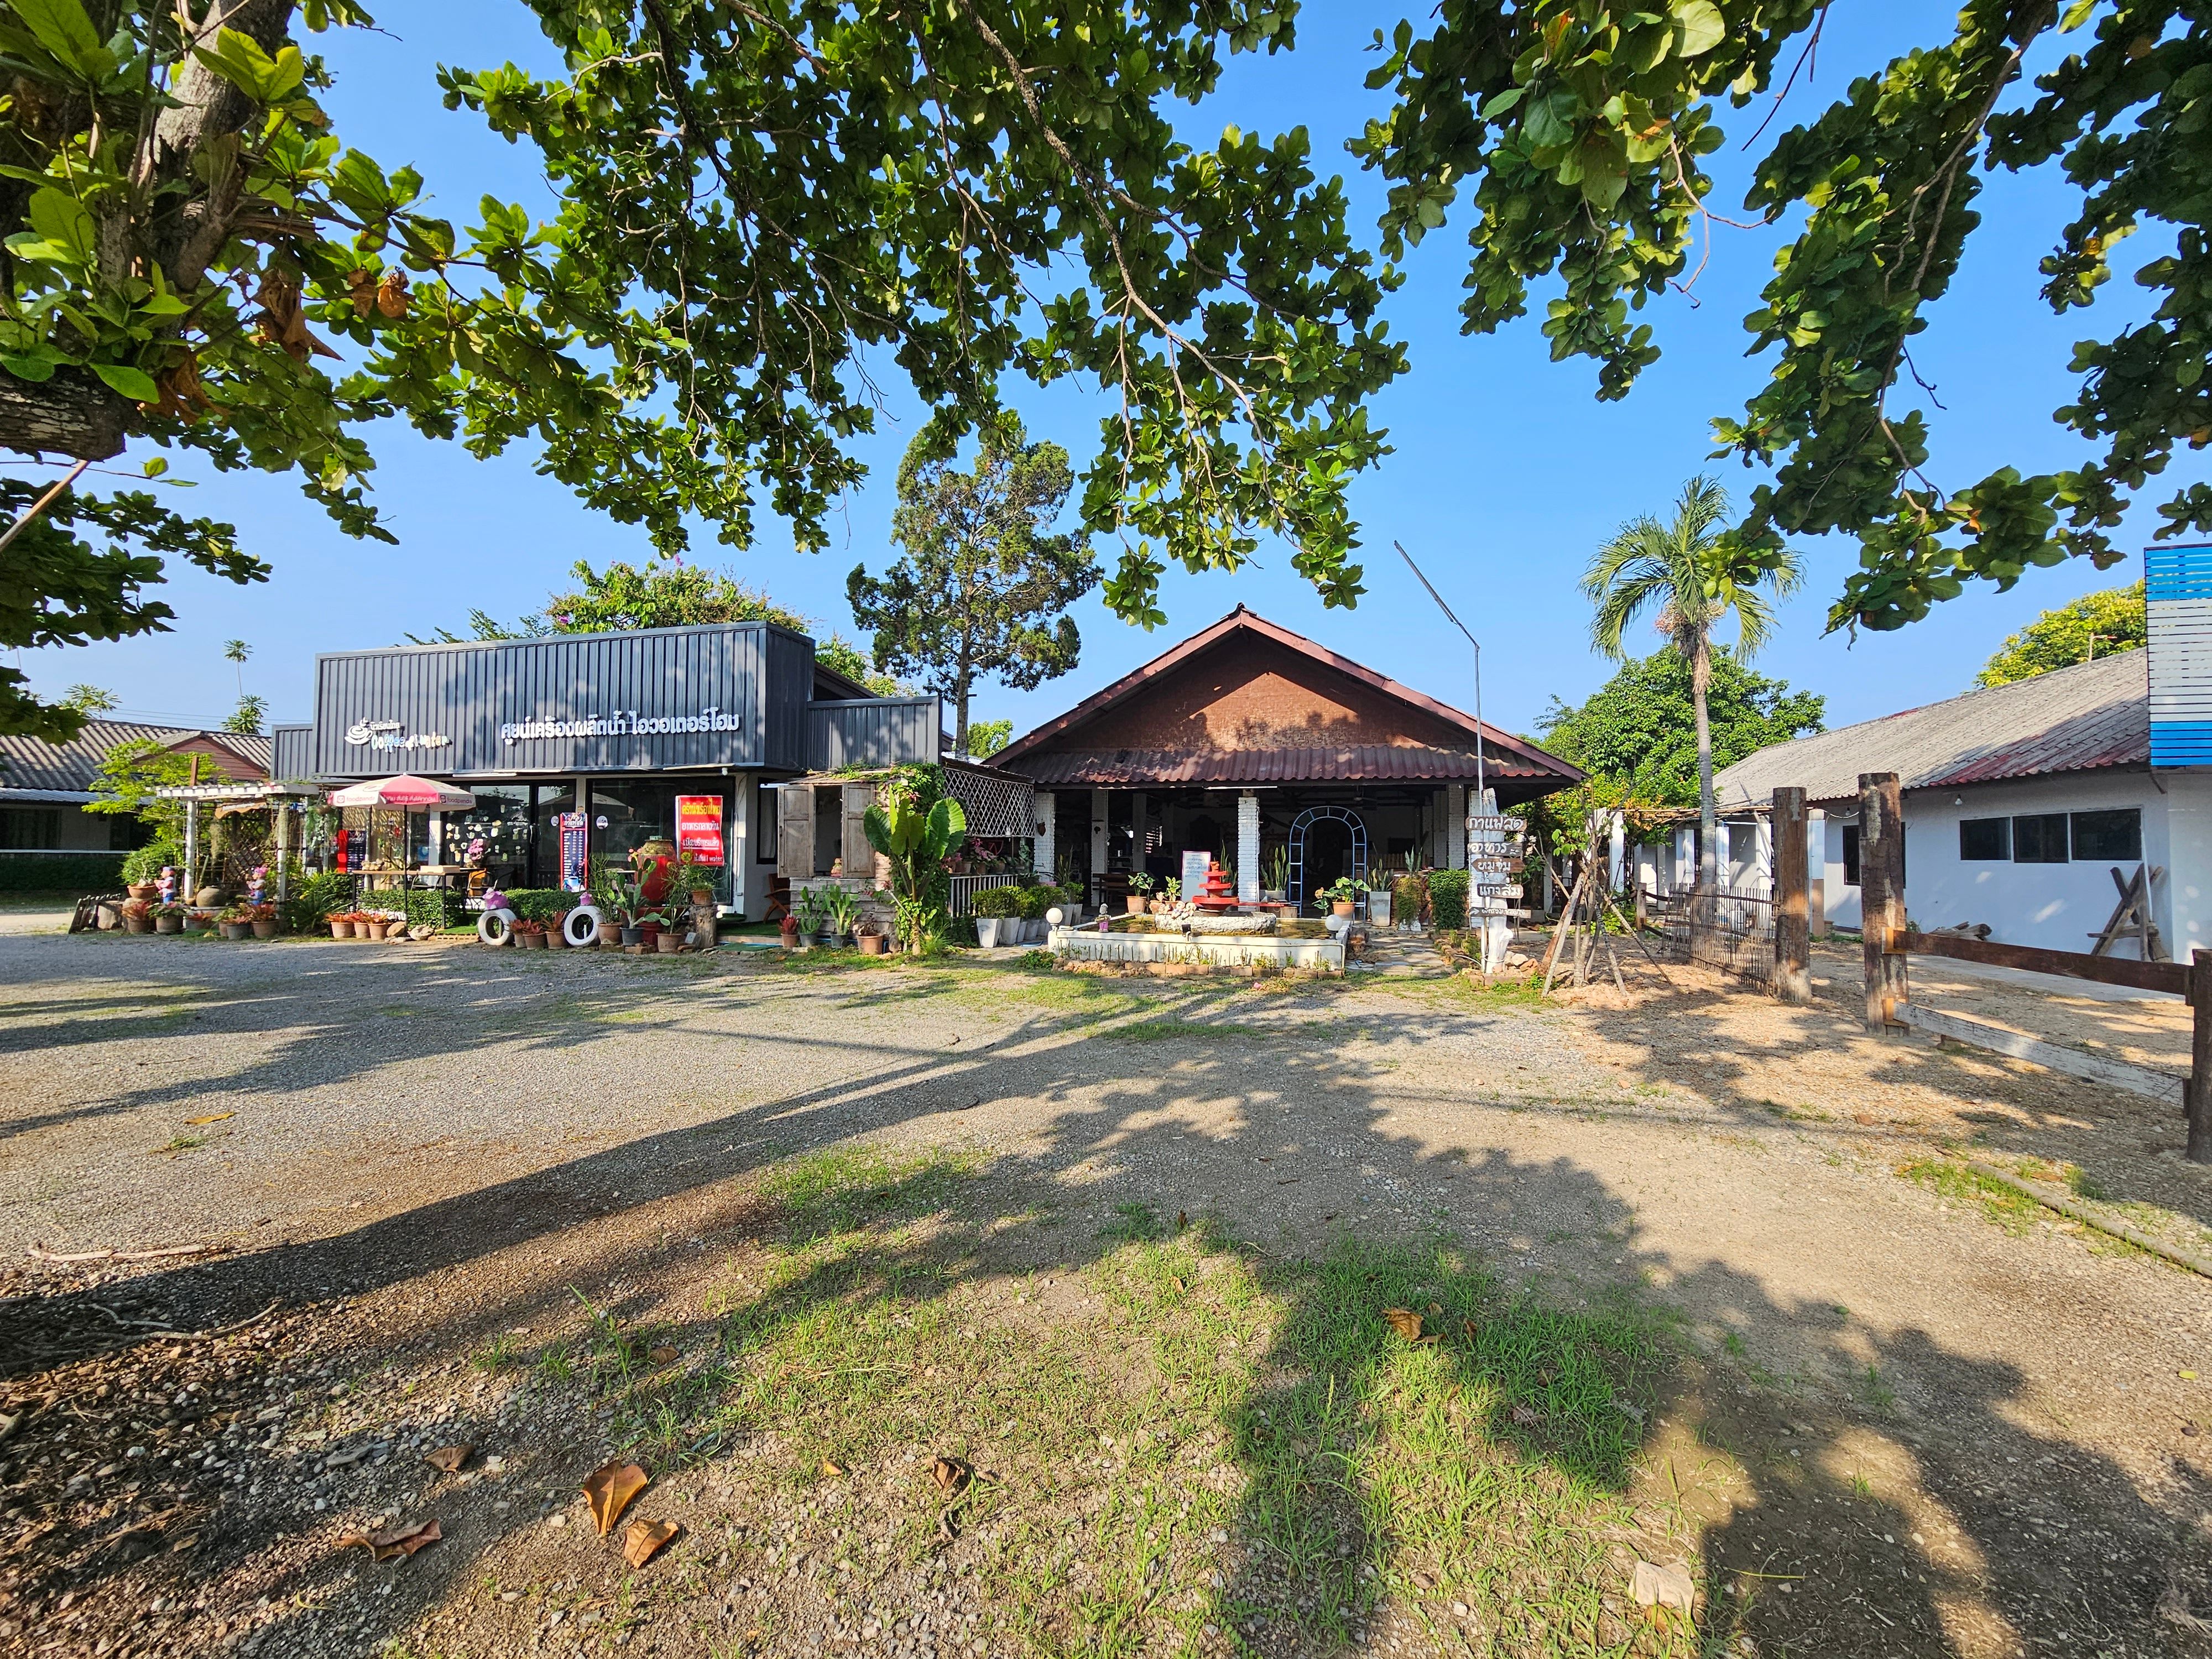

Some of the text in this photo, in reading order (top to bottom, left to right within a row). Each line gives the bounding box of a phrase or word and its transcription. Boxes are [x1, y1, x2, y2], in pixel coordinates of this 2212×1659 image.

[1469, 816, 1524, 830] กาแฟสด
[1480, 884, 1520, 896] แกงส้ม
